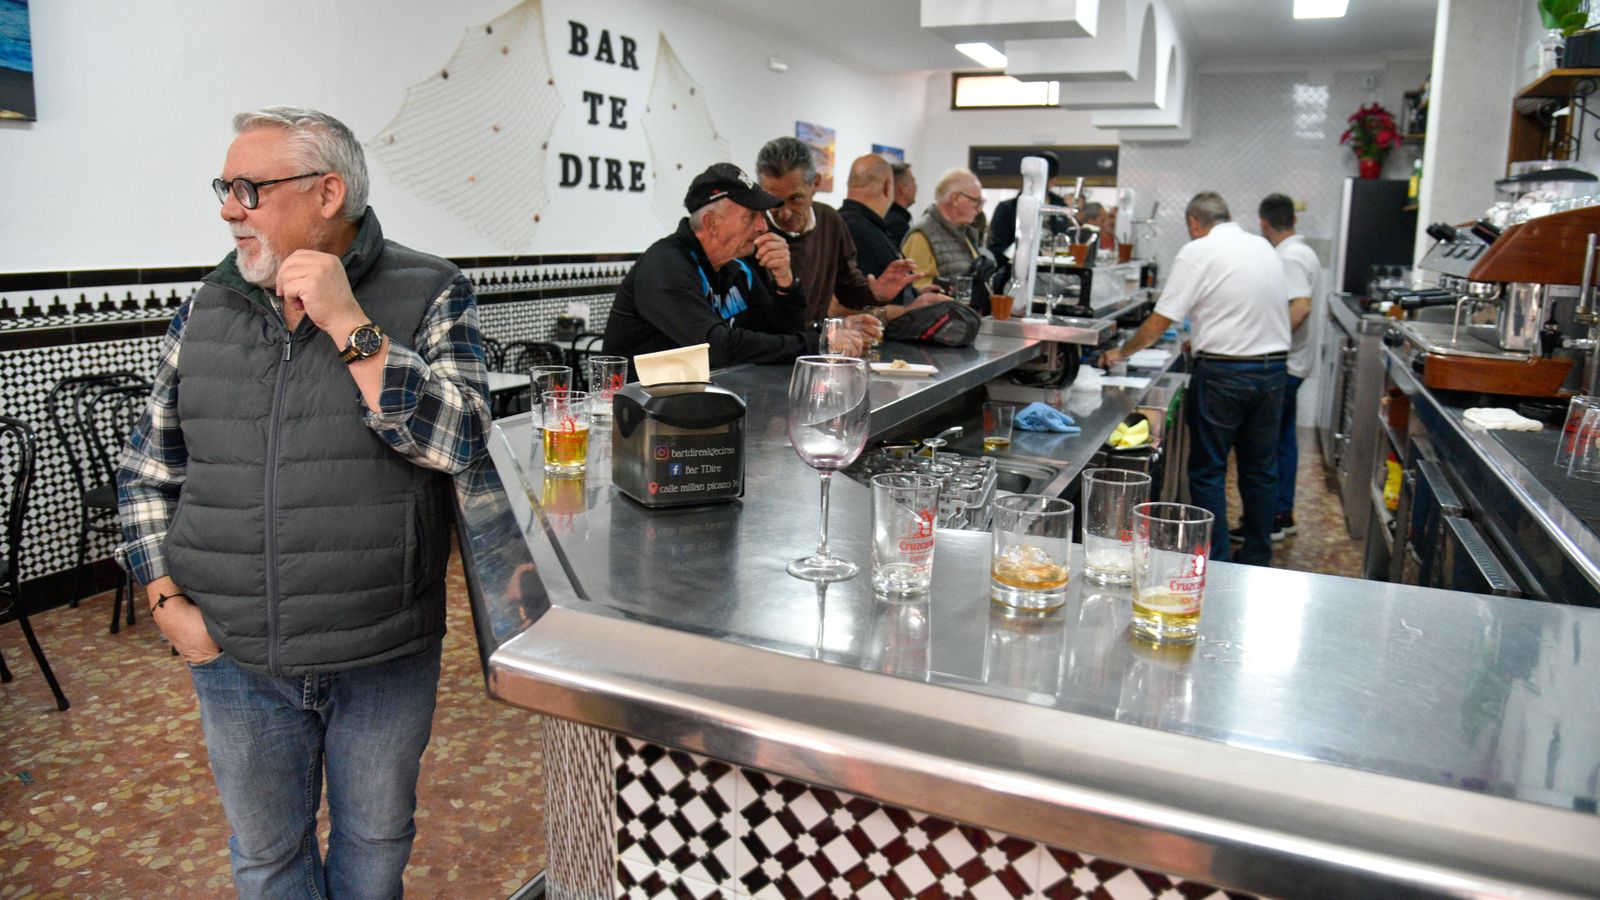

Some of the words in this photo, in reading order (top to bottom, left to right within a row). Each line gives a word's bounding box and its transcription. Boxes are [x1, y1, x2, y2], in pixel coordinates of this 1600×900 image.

[568, 20, 640, 71] BAR
[583, 90, 628, 130] TE
[558, 152, 646, 193] DIRE
[660, 484, 679, 494] calle
[685, 466, 699, 475] Bar
[701, 464, 722, 474] TDire
